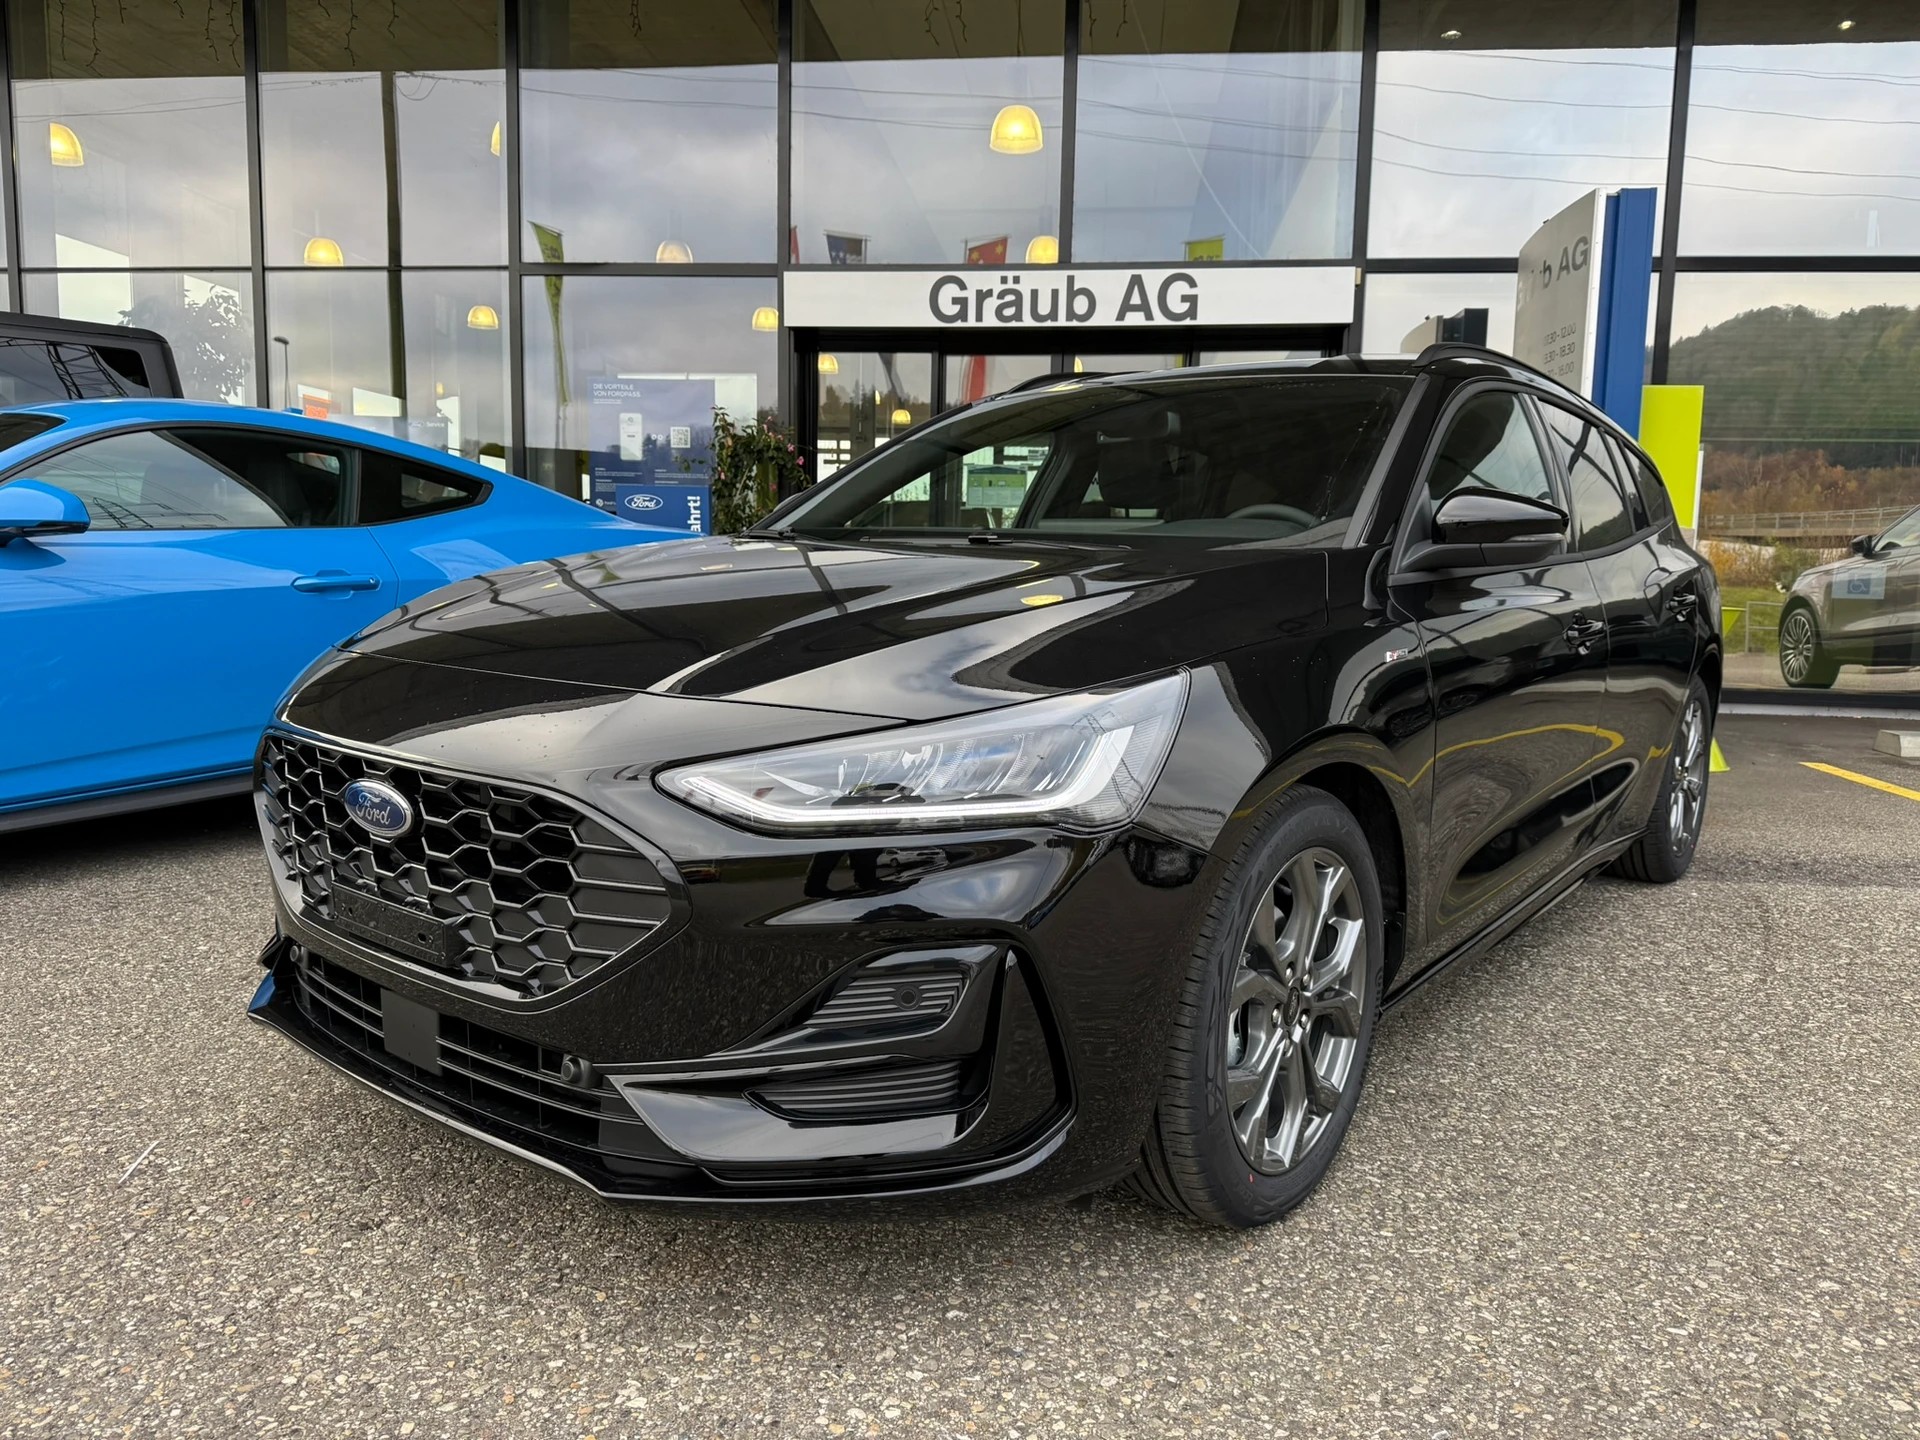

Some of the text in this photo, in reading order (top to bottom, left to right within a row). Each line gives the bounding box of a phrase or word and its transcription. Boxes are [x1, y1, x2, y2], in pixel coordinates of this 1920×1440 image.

[1557, 236, 1589, 281] AG
[929, 272, 1200, 324] Gräub AG
[631, 496, 657, 508] Ford
[356, 792, 391, 825] Ford
